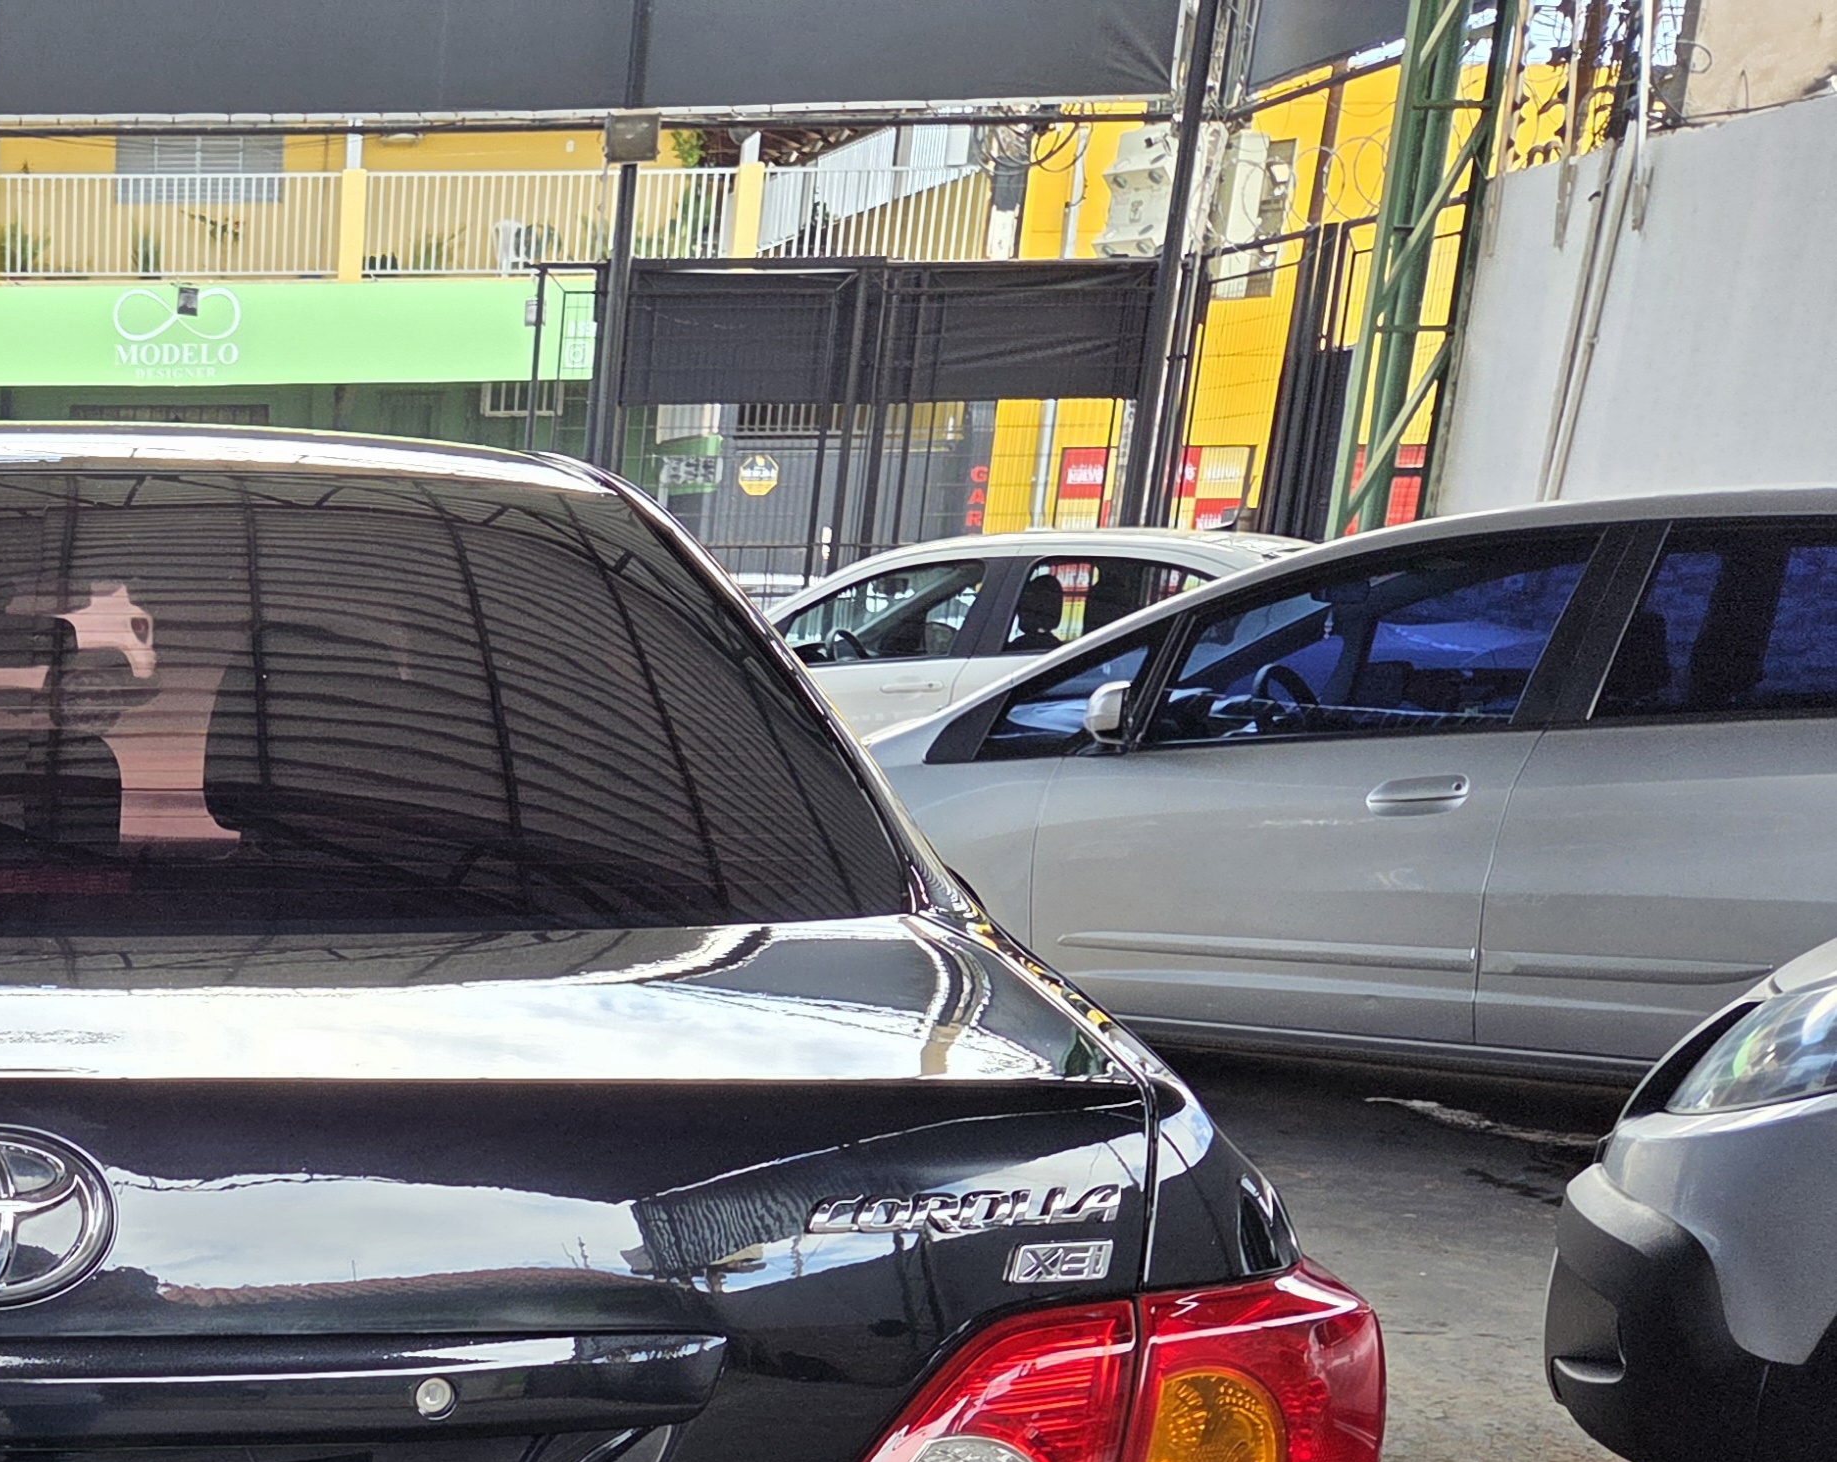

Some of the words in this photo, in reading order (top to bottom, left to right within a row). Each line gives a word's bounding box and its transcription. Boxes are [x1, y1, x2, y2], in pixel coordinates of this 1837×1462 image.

[114, 343, 240, 366] MODELO
[135, 367, 217, 380] DESIGNER
[965, 465, 989, 537] GAR
[804, 1183, 1122, 1234] COROLLA
